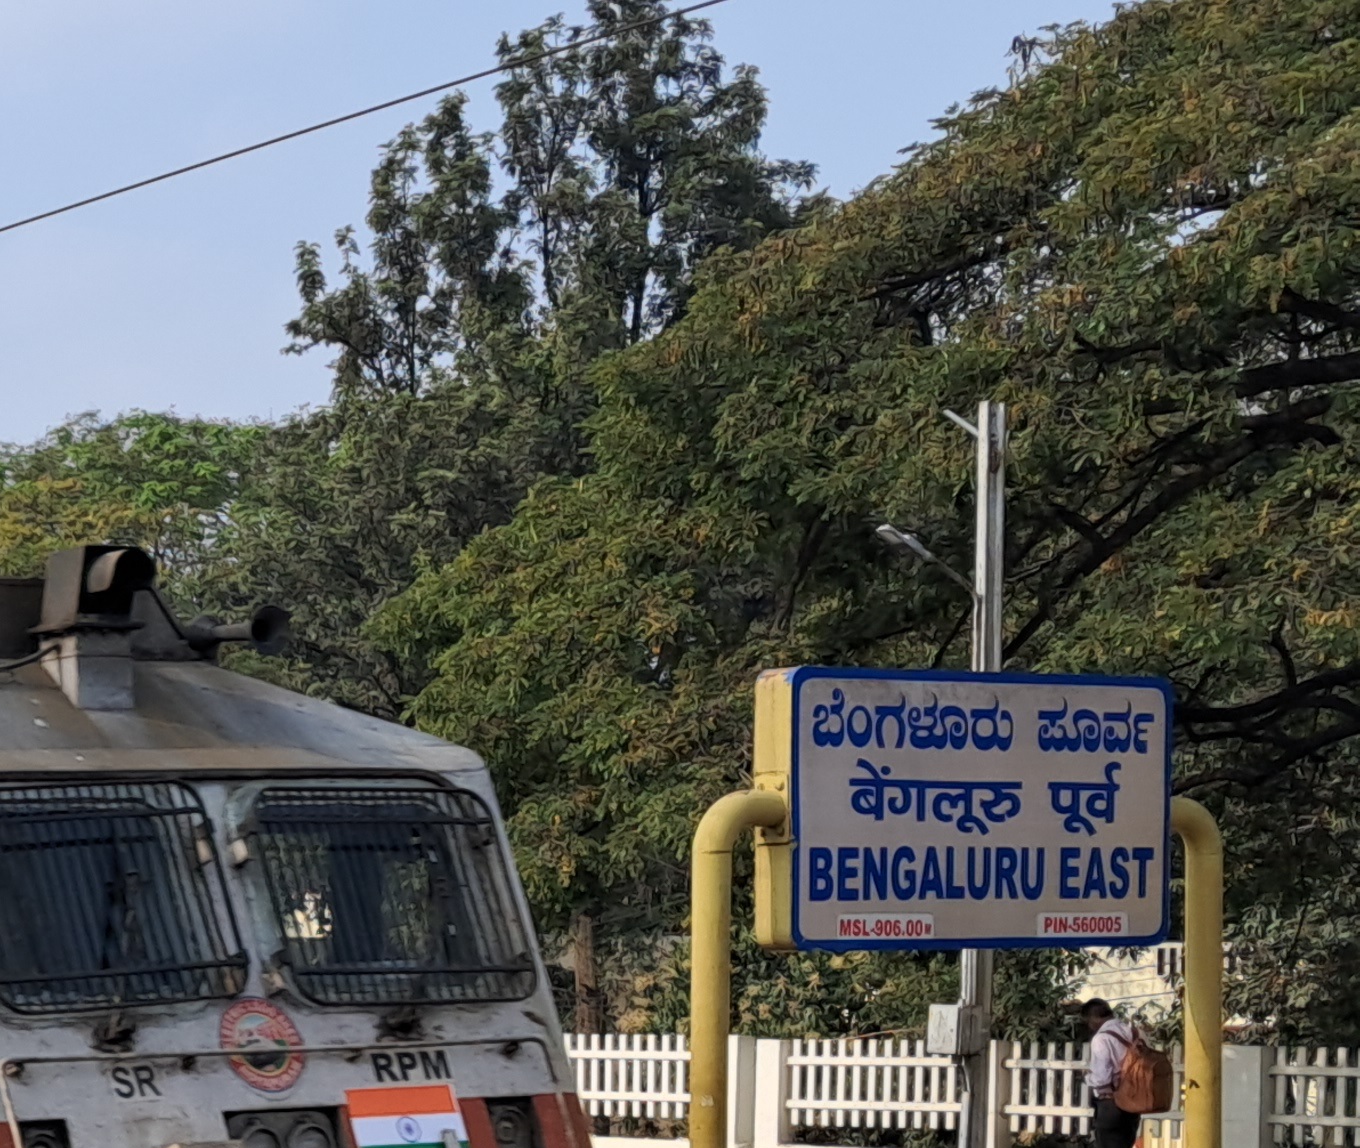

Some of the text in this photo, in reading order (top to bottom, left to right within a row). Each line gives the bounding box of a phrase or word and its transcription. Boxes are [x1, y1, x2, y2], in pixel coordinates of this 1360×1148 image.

[812, 688, 1014, 752] ಬೆಂಗಳೂರು
[849, 758, 1122, 836] बेंगलूरु पूर्व
[809, 846, 1155, 901] BENGALURU EAST
[1044, 916, 1122, 933] PIN-560005
[112, 1065, 162, 1098] SR
[371, 1050, 453, 1082] RPM
